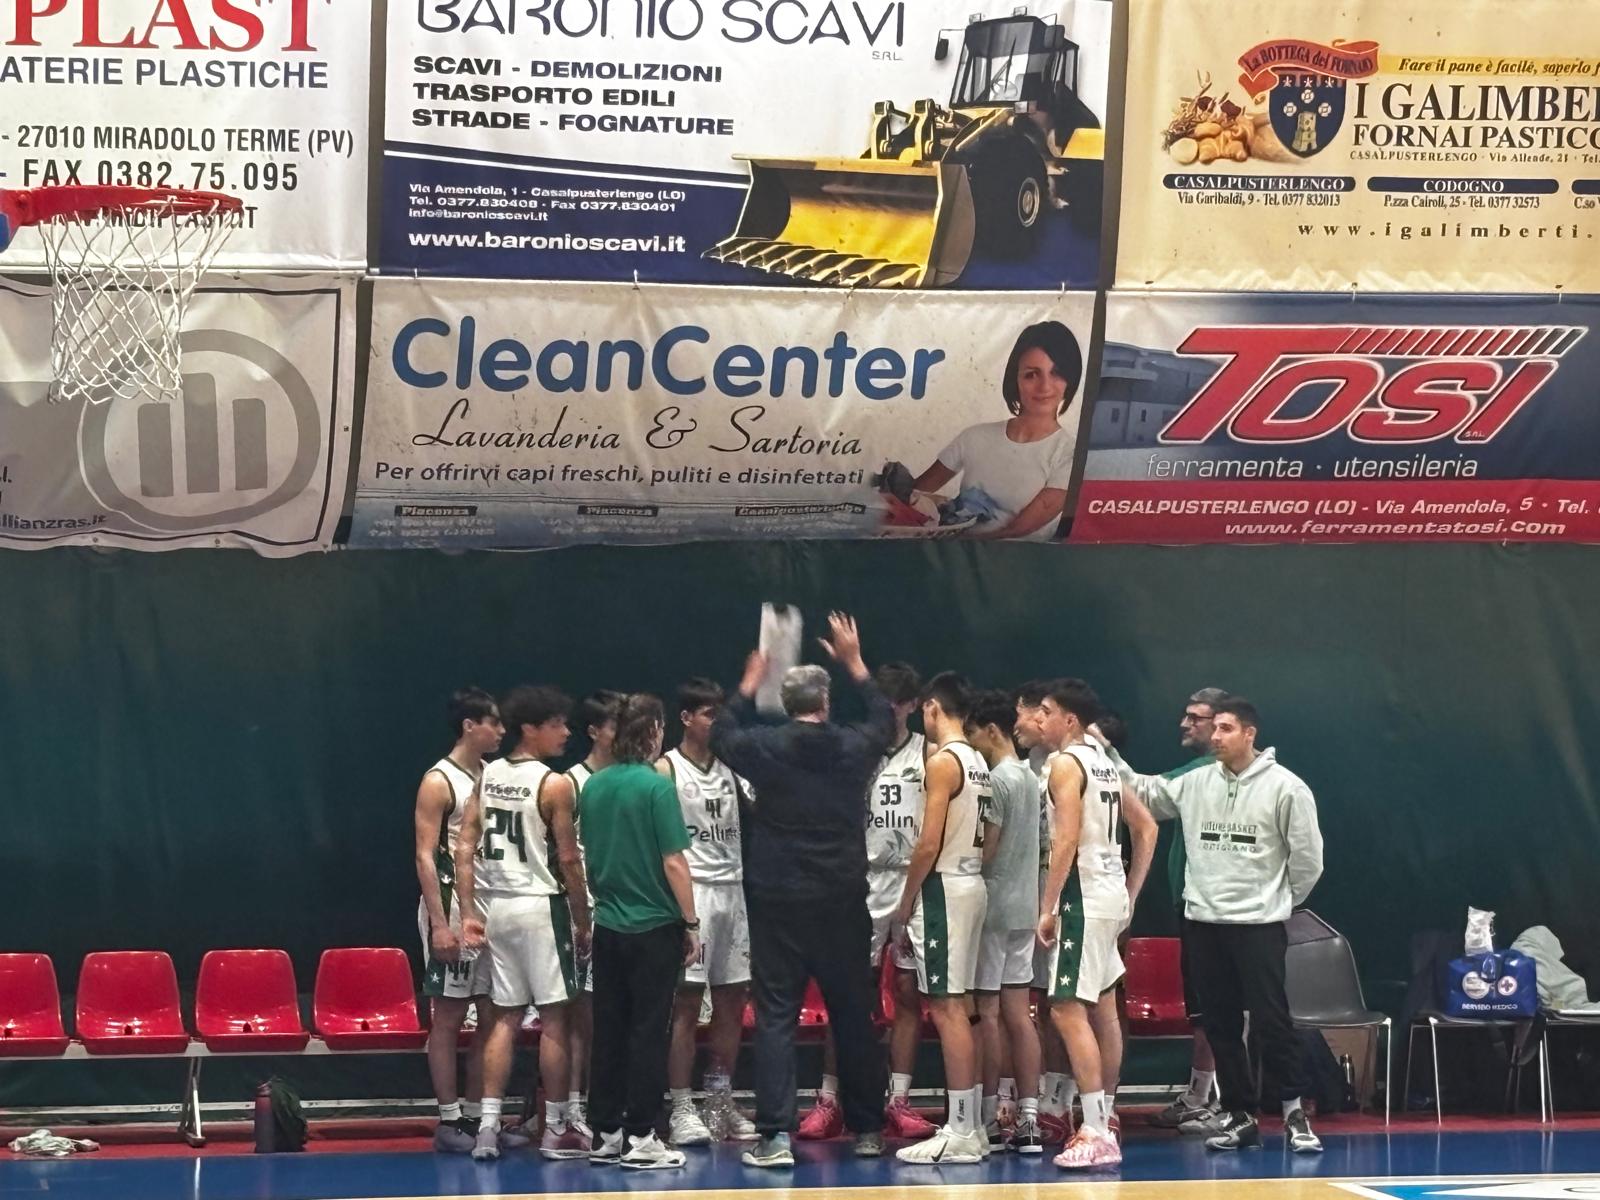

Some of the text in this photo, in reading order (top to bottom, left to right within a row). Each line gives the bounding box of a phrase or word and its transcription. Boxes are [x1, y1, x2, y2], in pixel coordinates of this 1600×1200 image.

[5, 0, 331, 52] PLAST
[721, 0, 904, 47] SCAVI
[1259, 45, 1310, 66] BOTTEGA
[1312, 50, 1330, 69] del
[1398, 58, 1432, 72] Fare
[1434, 57, 1446, 72] il
[1447, 62, 1482, 75] pane
[1485, 60, 1493, 72] è
[1494, 59, 1539, 75] facile,
[1542, 61, 1591, 76] saperlo
[0, 56, 328, 89] ATERIE PLASTICHE
[413, 56, 501, 76] SCAVI
[531, 60, 722, 83] DEMOLIZIONI
[413, 82, 676, 107] TRASPORTO EDILI
[1353, 83, 1370, 119] I
[412, 109, 531, 130] STRADE
[559, 114, 734, 136] FOGNATURE
[17, 125, 85, 149] 27010
[94, 126, 216, 152] MIRADOLO
[223, 128, 300, 153] TERME
[308, 129, 354, 157] (PV)
[1353, 124, 1474, 148] FORNAI
[1349, 150, 1478, 163] CASALPUSTERLENGO
[23, 159, 82, 187] FAX
[98, 160, 299, 191] 0382.75.095
[1174, 176, 1346, 191] CASALPUSTERLENGO
[1423, 180, 1505, 193] CODOGNO
[409, 183, 431, 193] Via
[435, 184, 506, 197] Amendola,
[658, 190, 686, 202] (LO)
[409, 196, 432, 206] Tel.
[551, 201, 576, 210] Fax
[1177, 192, 1194, 204] Via
[1196, 192, 1246, 206] Garibaldi,
[1247, 193, 1255, 205] 9
[1263, 193, 1280, 205] Tel.
[1282, 194, 1303, 205] 0377
[1449, 196, 1461, 207] 25
[1469, 196, 1486, 208] Tel.
[408, 207, 549, 222] info@baronioscavi.it
[408, 231, 686, 253] www.baronioscavi.it
[392, 315, 946, 400] CleanCenter
[1157, 324, 1589, 444] TOSI
[412, 398, 620, 450] Lavanderia
[708, 405, 862, 455] Sartoria
[375, 462, 863, 487] Per offrirvi capi freschi, puliti e disinfettati
[1147, 454, 1303, 478] ferramenta
[1333, 454, 1478, 478] utensileria
[1088, 499, 1309, 515] CASALPUSTERLENGO
[1315, 500, 1356, 514] (LO)
[1376, 499, 1405, 514] Via
[1411, 499, 1511, 516] Amendola,
[1519, 497, 1533, 511] 5
[1557, 499, 1589, 514] Tel.
[1225, 518, 1566, 535] www.ferramentatosi.com
[879, 784, 902, 806] 33
[483, 806, 528, 863] 24
